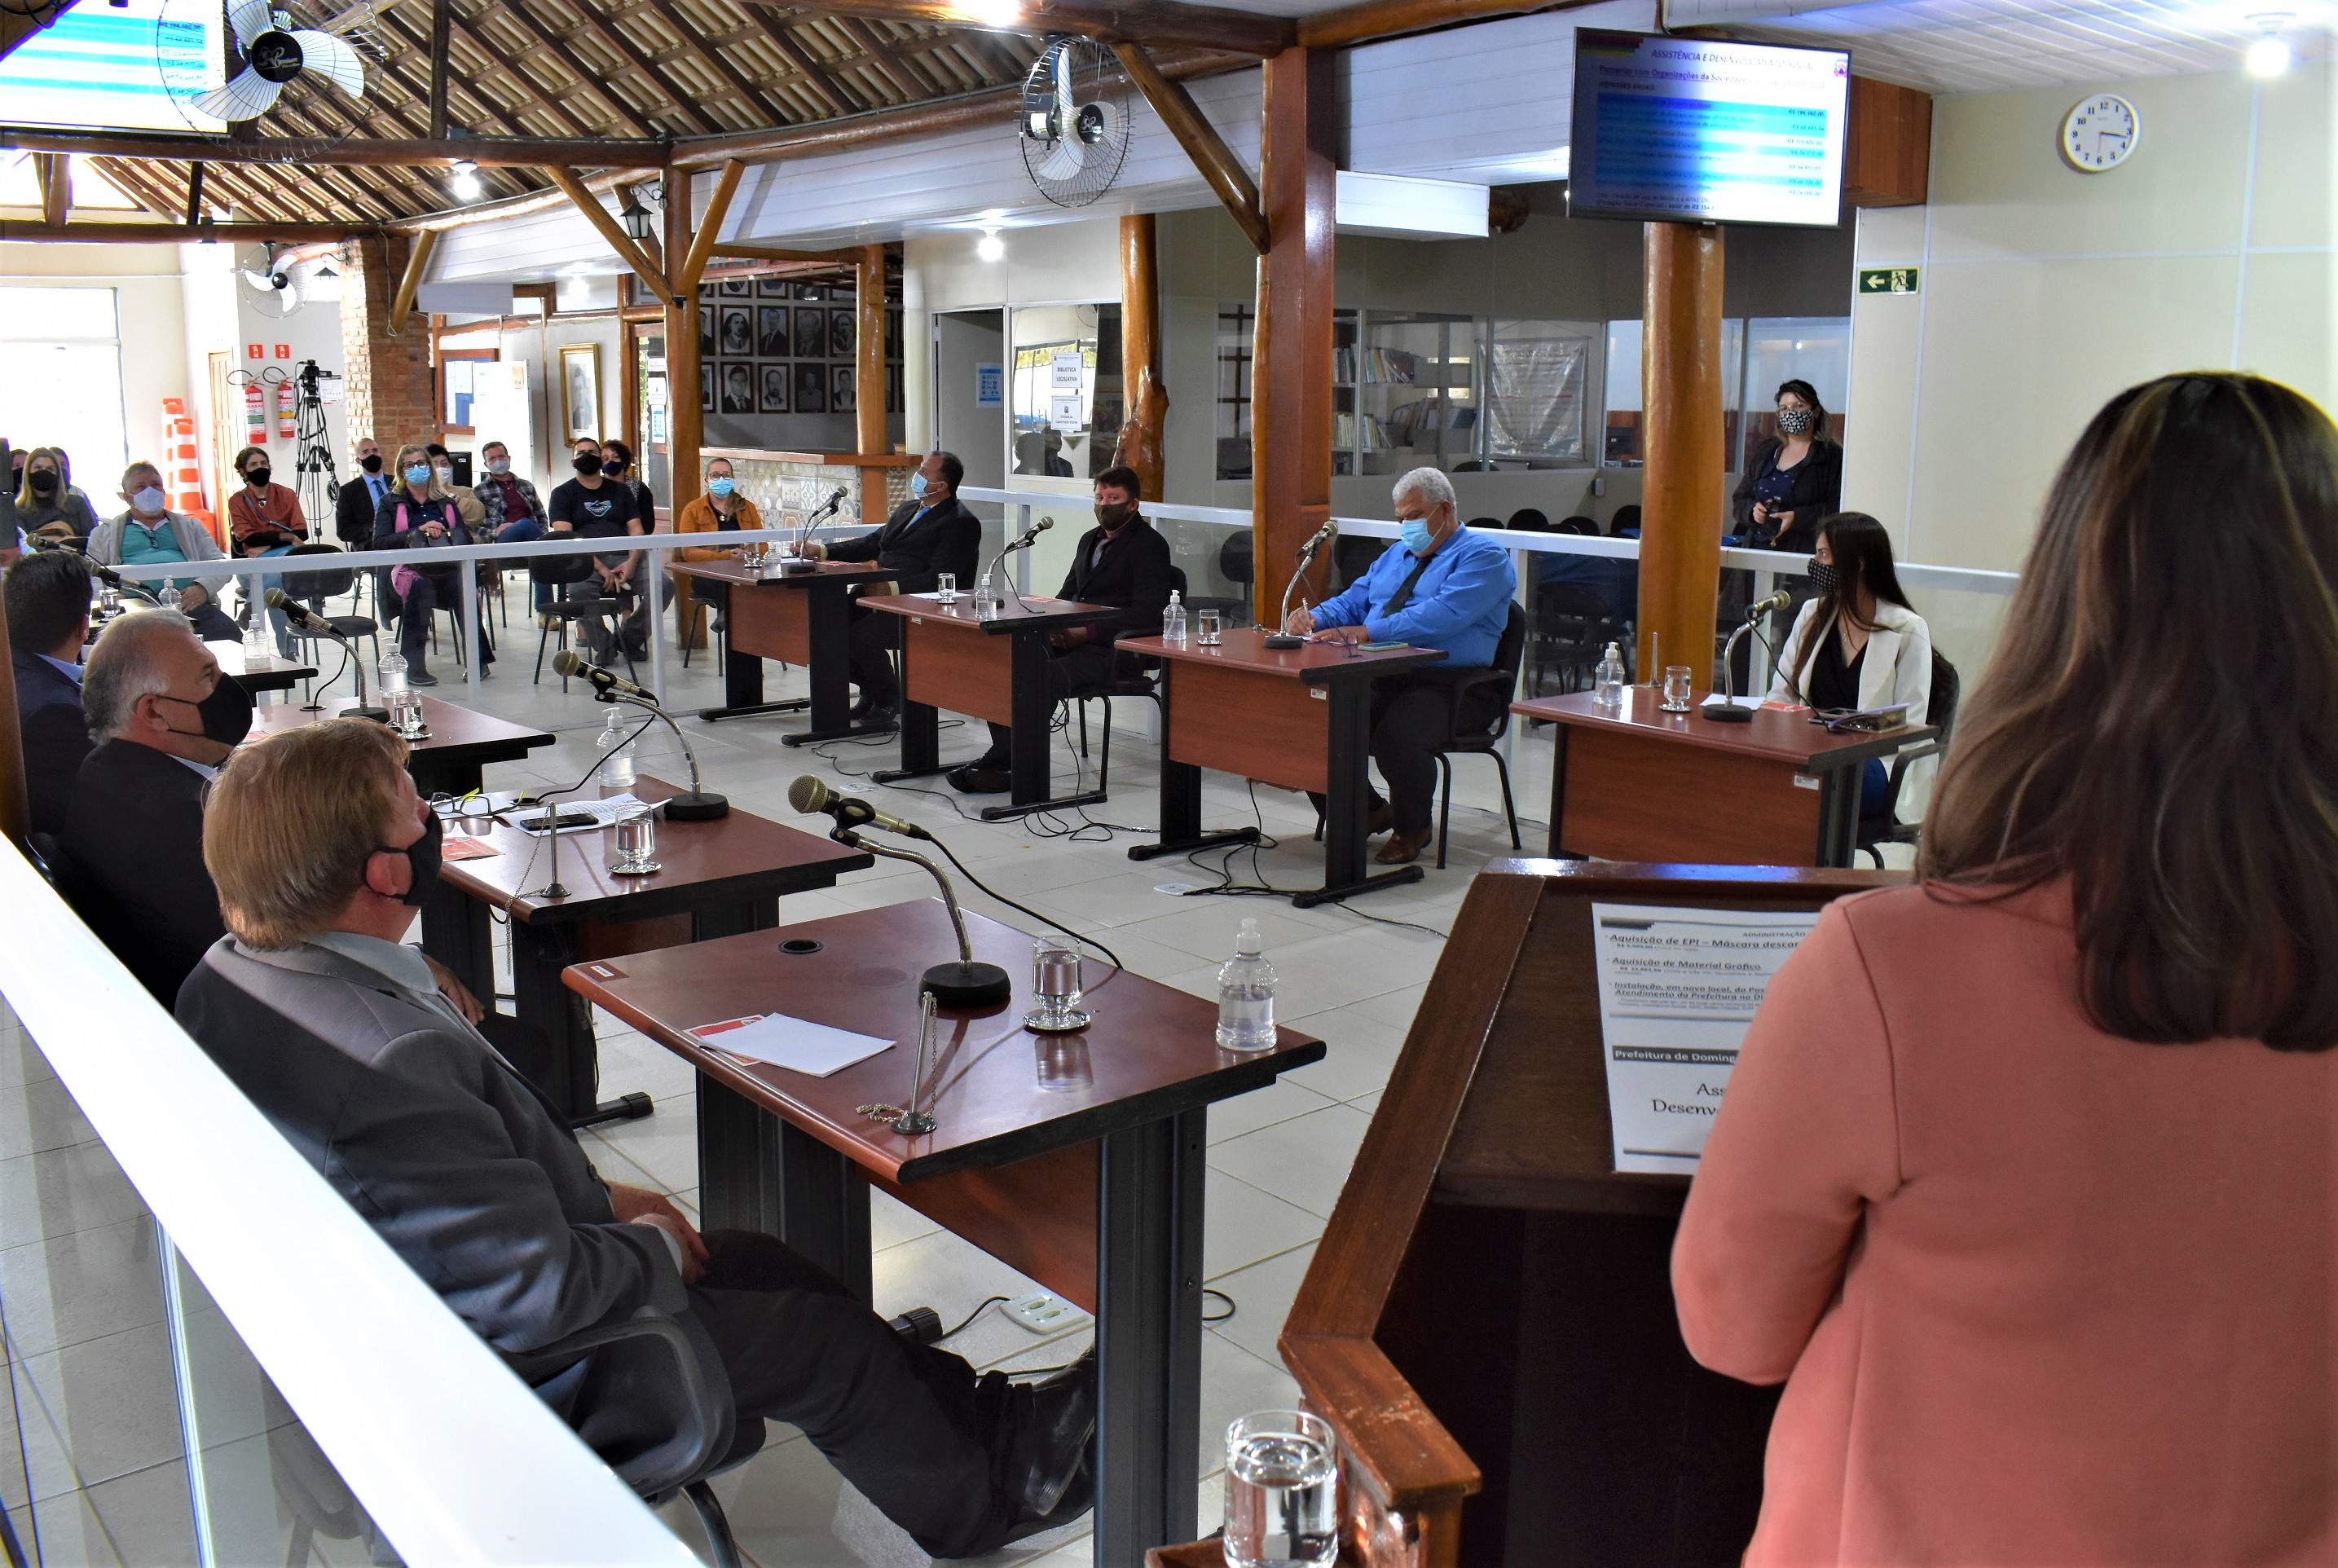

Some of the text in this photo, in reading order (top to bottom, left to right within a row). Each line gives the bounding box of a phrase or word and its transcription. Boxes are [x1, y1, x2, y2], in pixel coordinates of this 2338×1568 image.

[1651, 50, 1700, 61] ASSISTÊNCIA
[1652, 69, 1699, 80] Organizações
[1701, 73, 1710, 81] da
[2088, 106, 2094, 114] 11
[2100, 102, 2108, 110] 12
[2116, 104, 2119, 112] 1
[2077, 117, 2086, 125] 10
[2072, 130, 2078, 139] 9
[2126, 127, 2132, 135] 3
[2076, 143, 2080, 152] 8
[2120, 141, 2126, 149] 4
[2097, 156, 2102, 165] 6
[2111, 152, 2116, 160] 5
[1610, 934, 1662, 945] Aquisição
[1666, 936, 1680, 945] de
[1712, 940, 1759, 948] Máscara
[1612, 957, 1761, 971] Aquisição de Material Gráfico
[1614, 981, 1664, 991] Instalação,
[1708, 985, 1733, 993] local,
[1615, 989, 1675, 998] Atendimento
[1615, 1050, 1671, 1060] Prefeitura
[1675, 1051, 1689, 1060] de
[1651, 1099, 1719, 1116] Desenv
